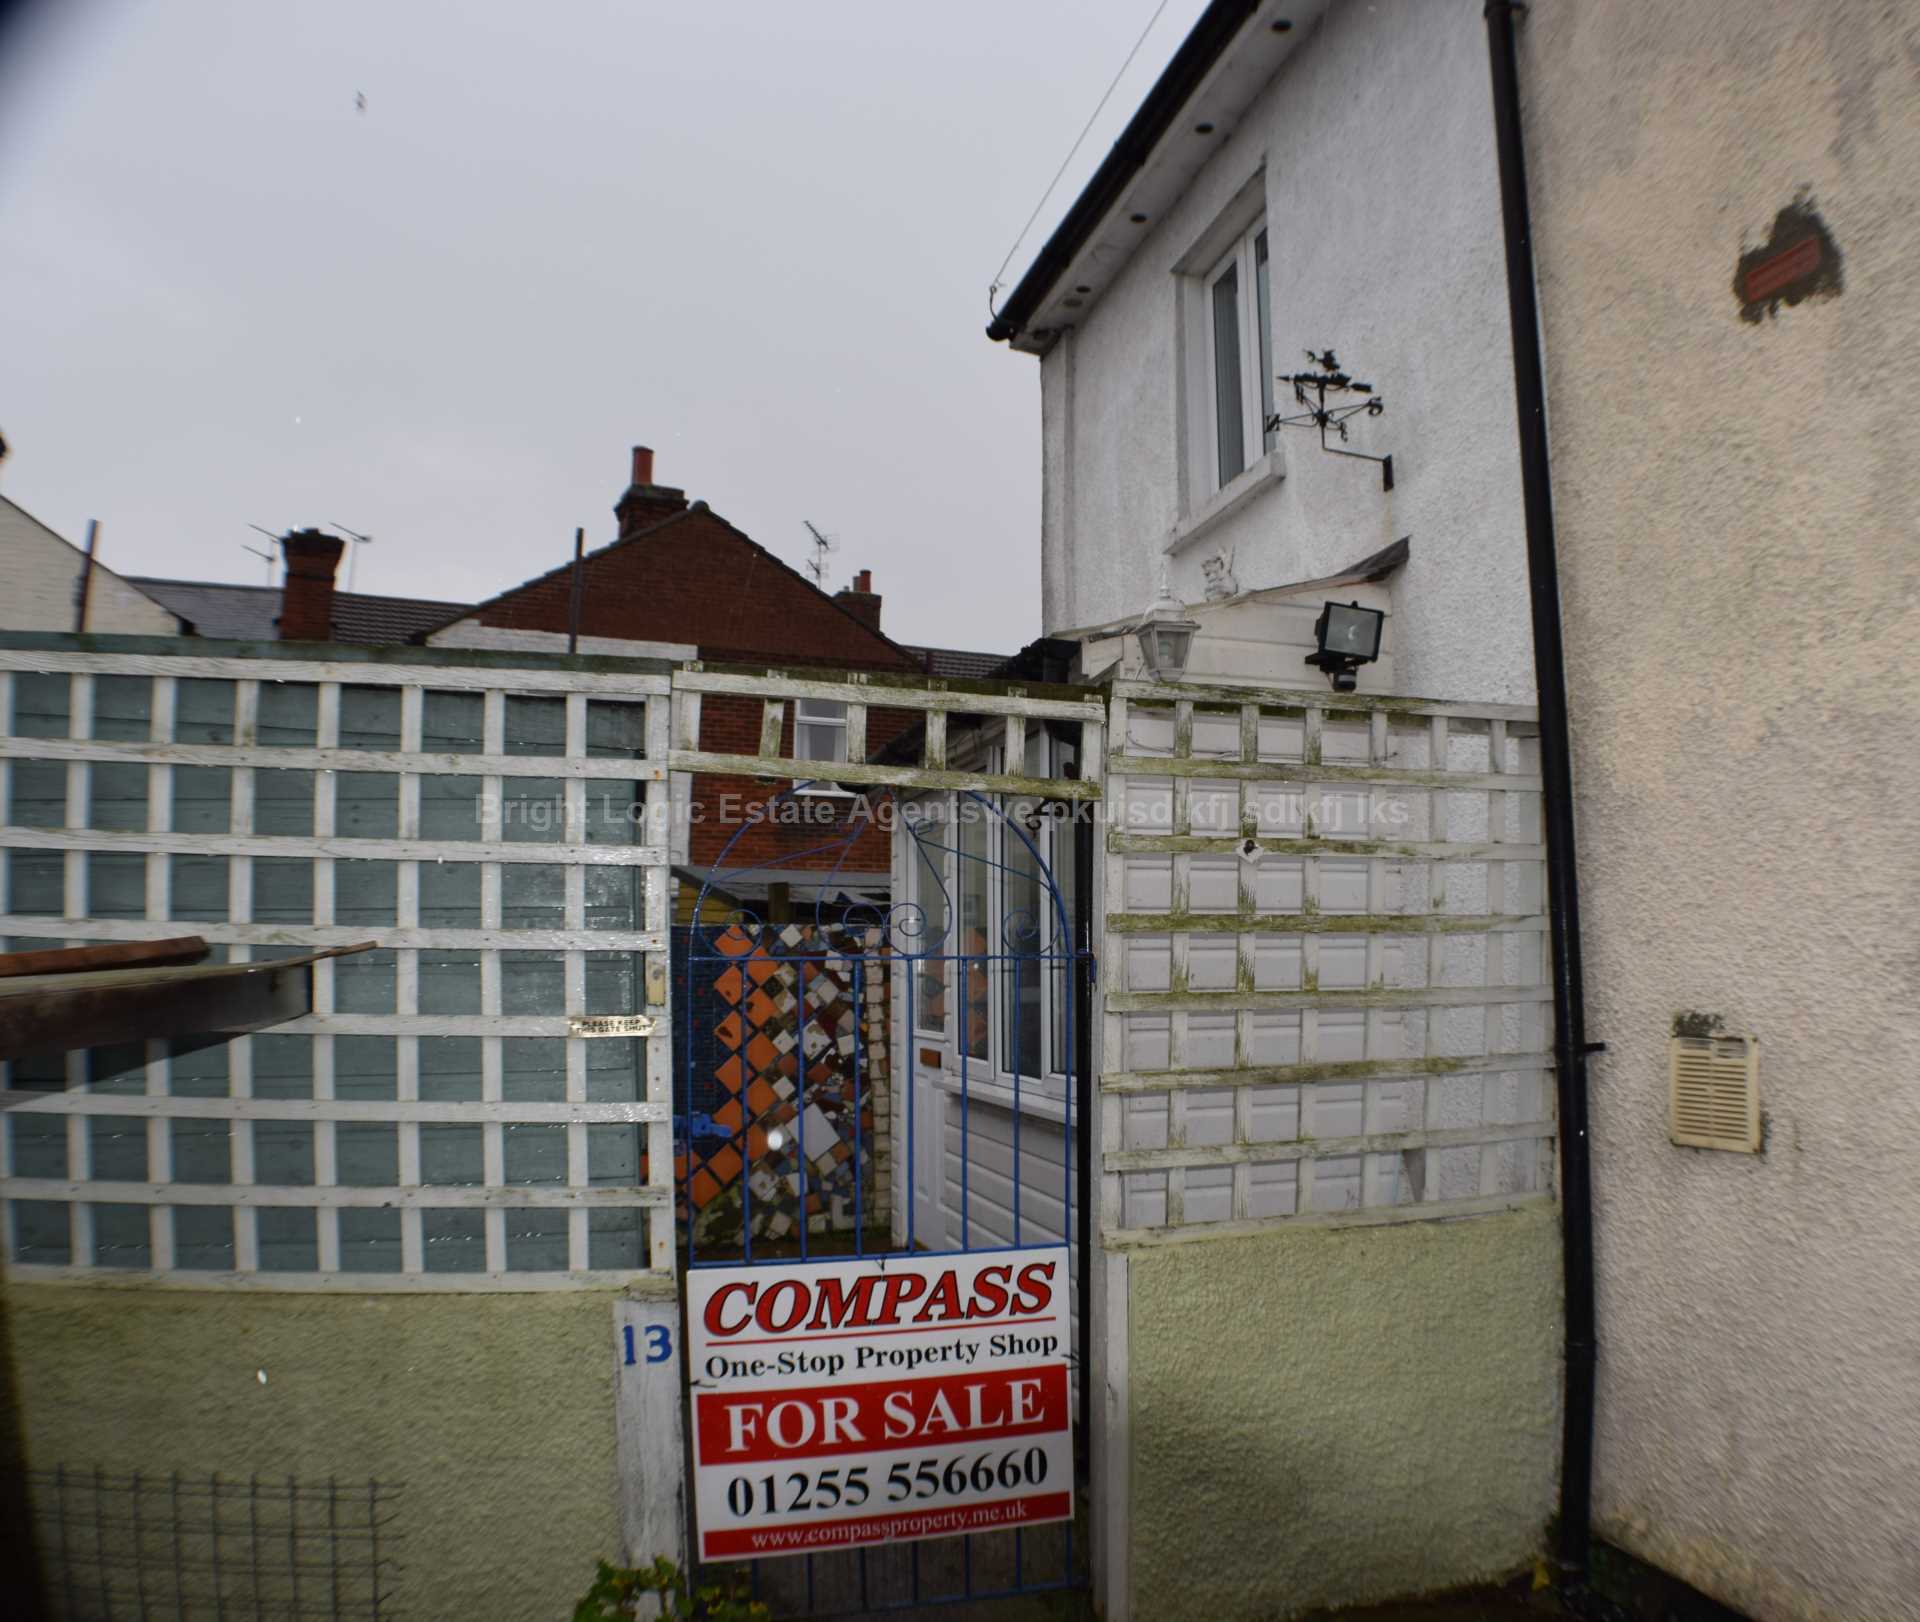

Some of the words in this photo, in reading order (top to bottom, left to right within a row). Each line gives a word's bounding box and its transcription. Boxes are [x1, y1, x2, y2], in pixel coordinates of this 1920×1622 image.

[703, 1261, 1056, 1338] COMPASS
[623, 1324, 673, 1367] 13
[705, 1351, 845, 1380] One-Stop
[856, 1338, 981, 1371] Property
[989, 1332, 1059, 1360] Shop
[725, 1396, 867, 1453] FOR
[883, 1378, 1045, 1441] SALE
[727, 1466, 871, 1518] 01255
[887, 1446, 1049, 1501] 556660
[751, 1500, 1028, 1549] www.compassproperty.me.uk
